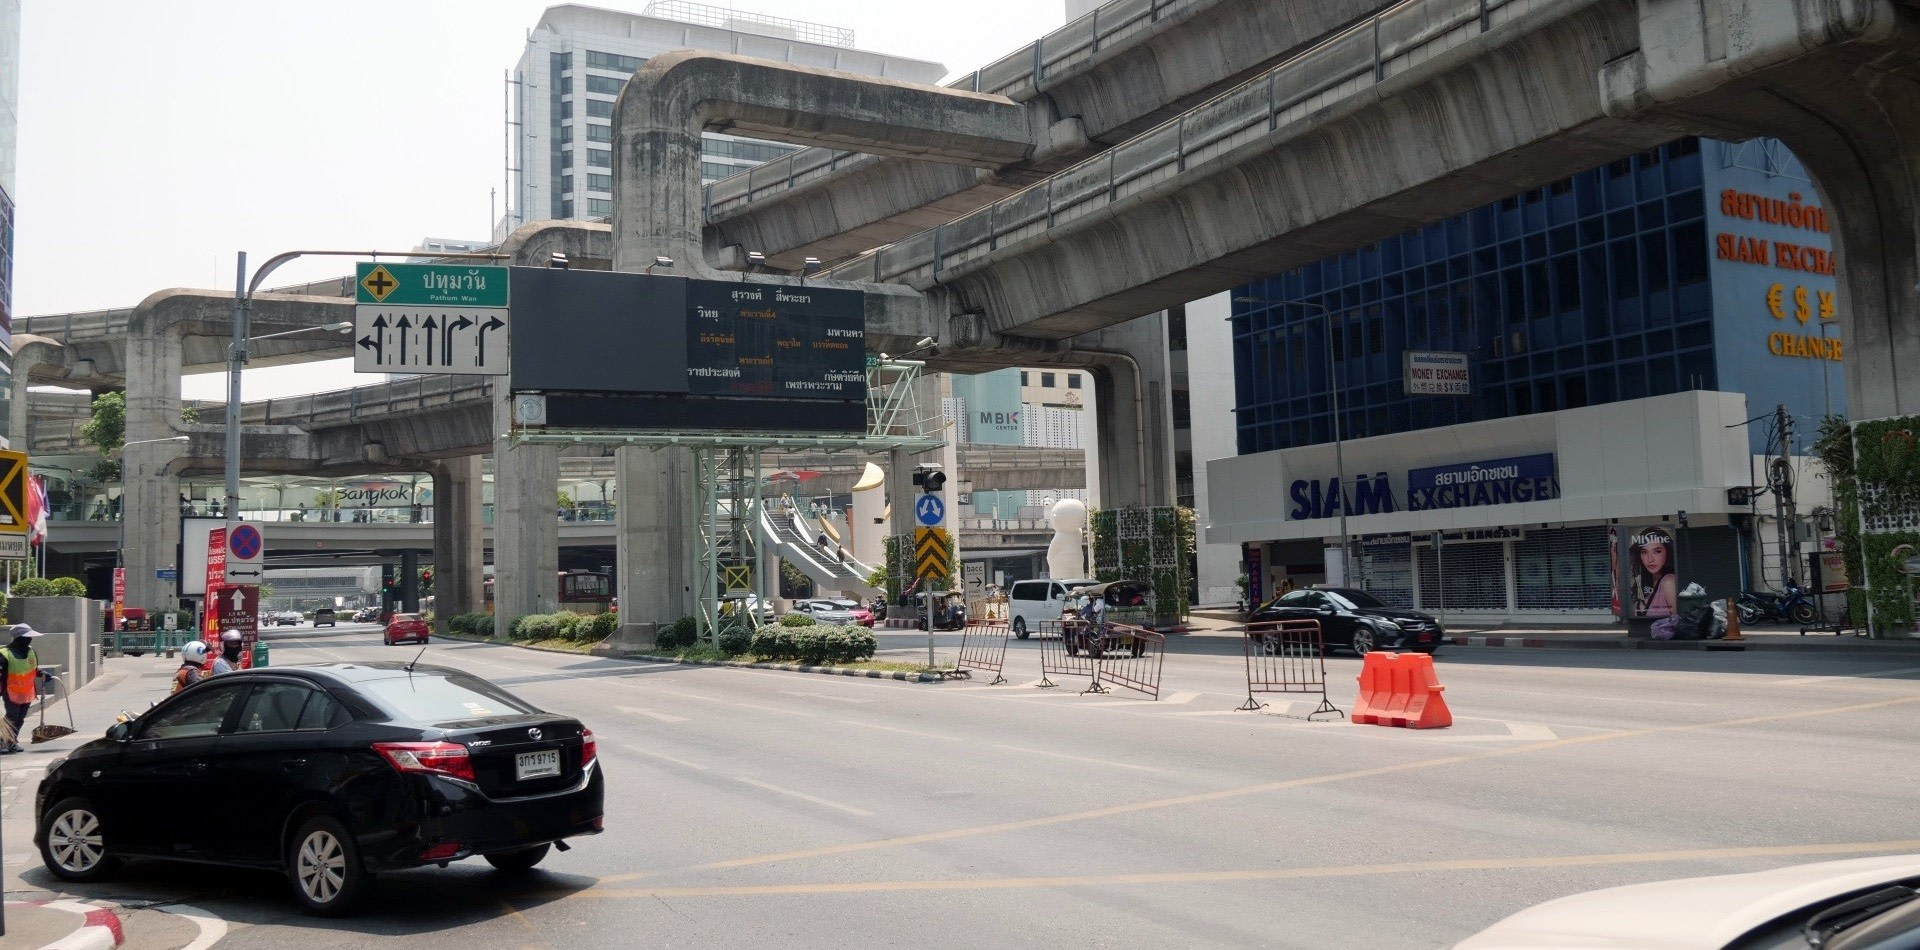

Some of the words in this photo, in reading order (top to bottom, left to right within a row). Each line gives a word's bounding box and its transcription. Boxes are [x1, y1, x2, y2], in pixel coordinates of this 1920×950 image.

[1717, 233, 1770, 266] SIAM
[422, 269, 486, 294] ปทุมวัน
[731, 288, 762, 302] สุรวงศ์
[775, 288, 810, 303] สี่พระยา
[697, 305, 719, 321] วิทยุ
[827, 328, 863, 338] มหานคร
[1768, 332, 1843, 361] CHANGE
[687, 366, 741, 378] ราชประสงค์
[1411, 368, 1433, 379] MONEY
[1436, 369, 1467, 380] EXCHANGE
[785, 381, 842, 390] เพชรพระราม
[980, 412, 1019, 424] MBK
[1290, 472, 1394, 520] SIAM
[967, 565, 983, 573] bacc
[537, 752, 556, 765] 9715
